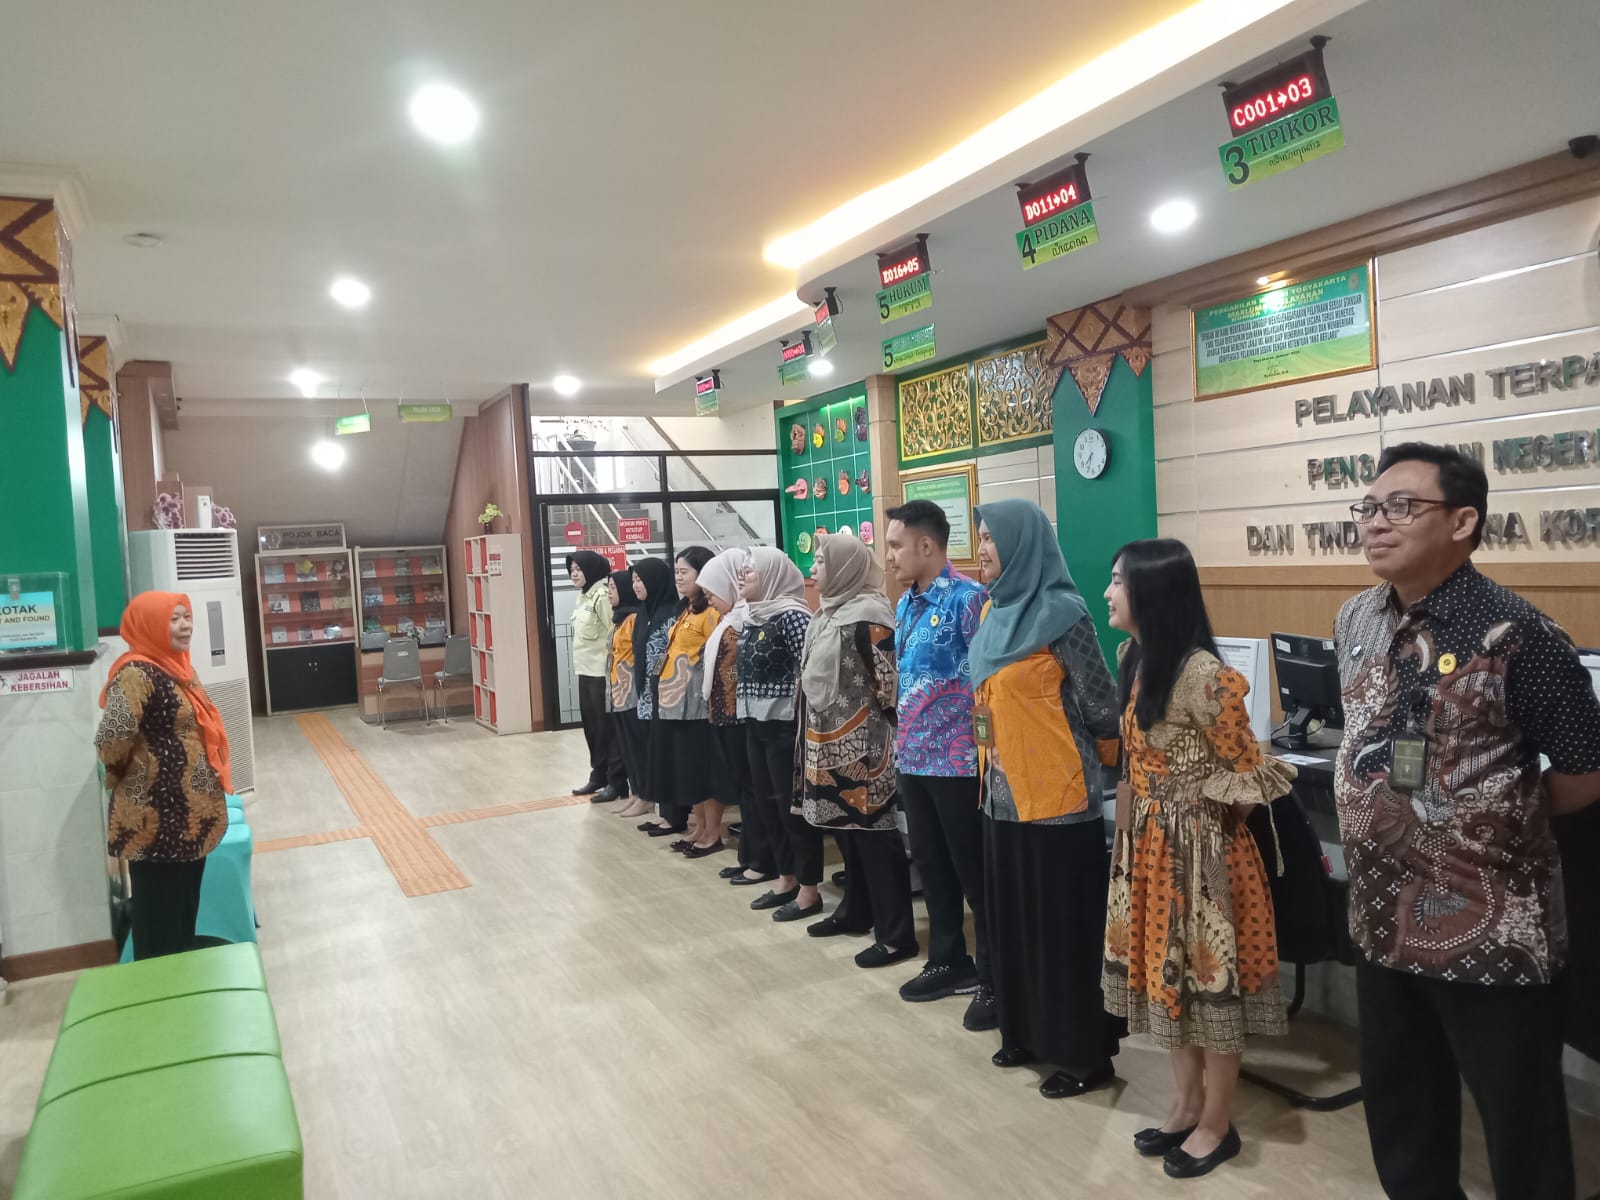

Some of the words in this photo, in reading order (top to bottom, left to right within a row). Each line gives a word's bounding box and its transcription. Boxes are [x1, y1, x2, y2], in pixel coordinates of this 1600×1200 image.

[1233, 94, 1278, 126] C001
[1287, 78, 1312, 102] 03
[1247, 105, 1335, 156] TIPIKOR
[1226, 146, 1250, 184] 3
[1060, 184, 1077, 204] 04
[1034, 209, 1091, 244] PIDANA
[1022, 233, 1036, 264] 4
[890, 278, 927, 303] HUKUM
[880, 295, 890, 319] 5
[884, 343, 894, 368] 5
[1295, 372, 1475, 426] PELAYANAN
[1246, 524, 1295, 554] DAN
[0, 604, 37, 616] OTAK
[22, 615, 50, 623] FOUND
[11, 681, 68, 693] KEBERSIHAN
[18, 671, 60, 681] JAGALAH
